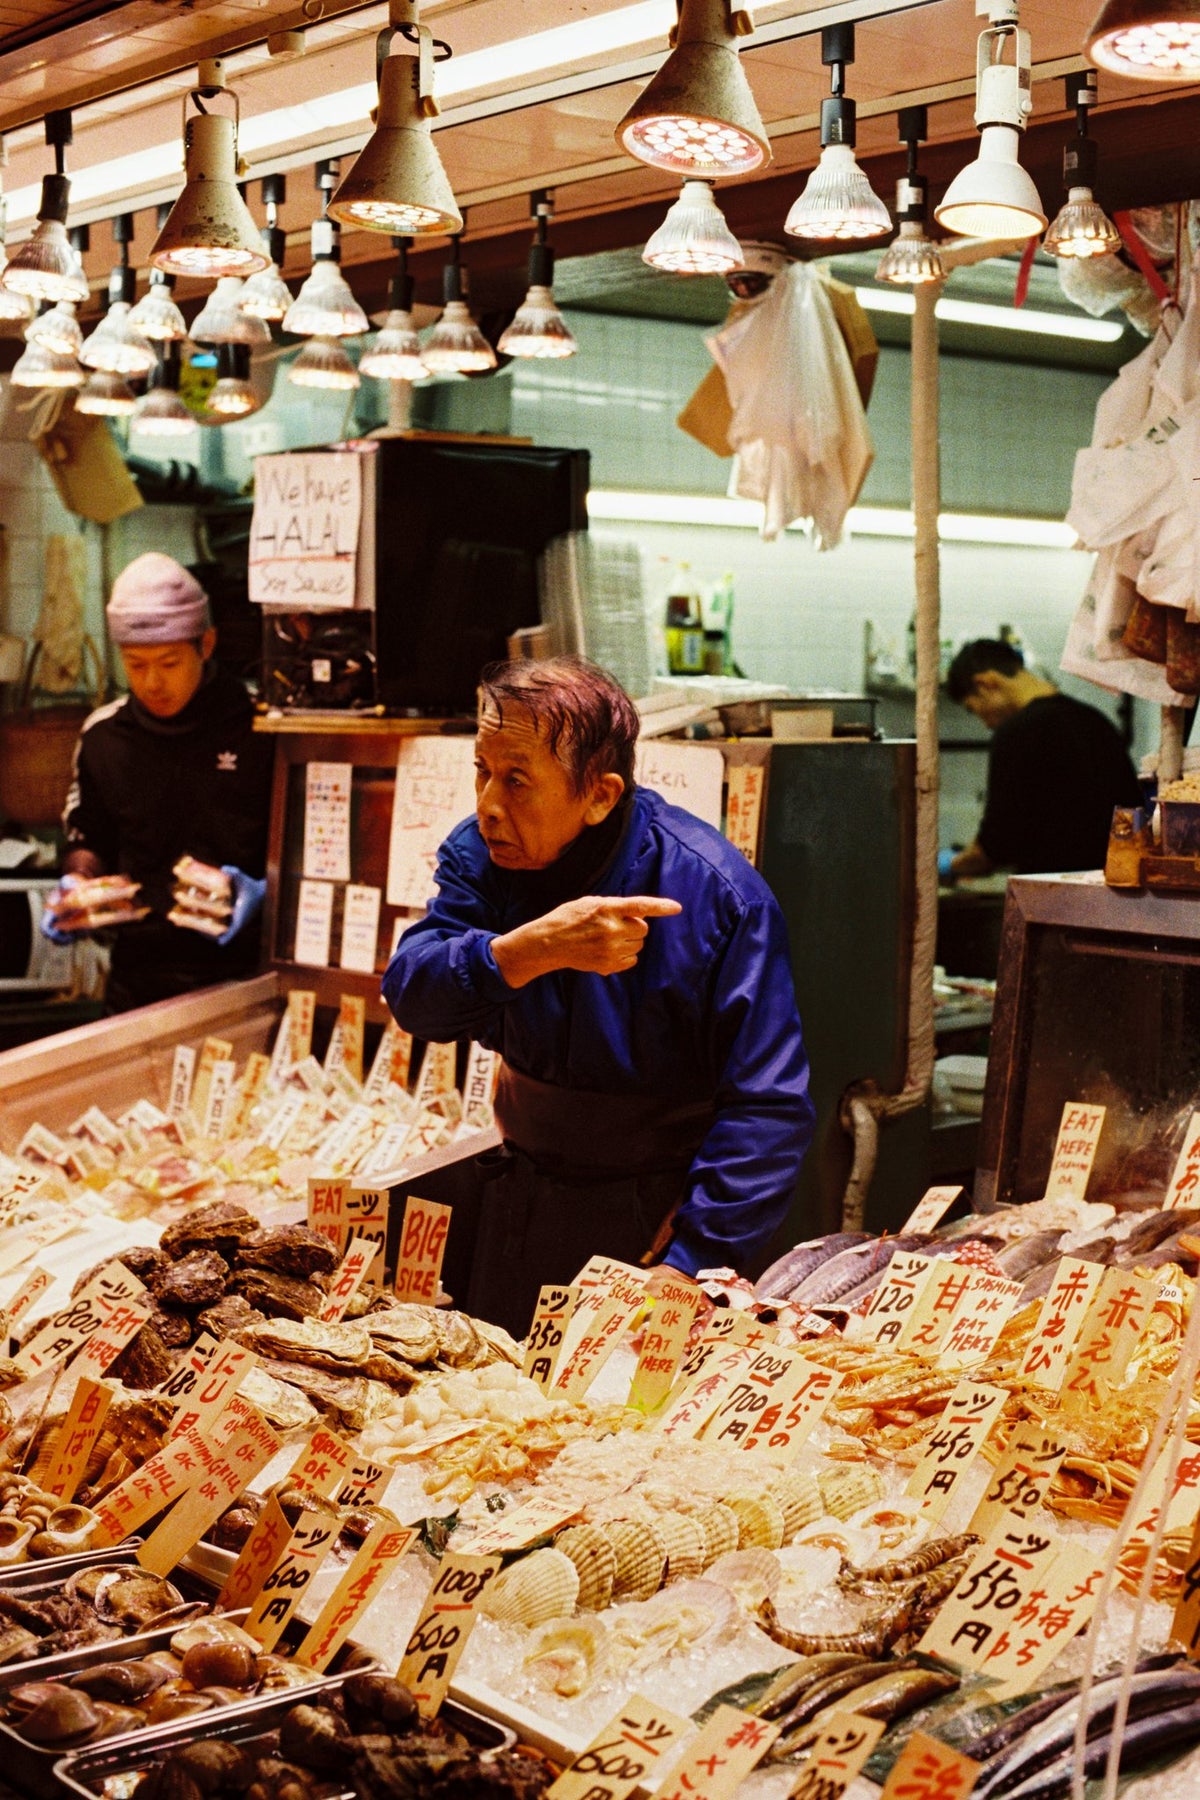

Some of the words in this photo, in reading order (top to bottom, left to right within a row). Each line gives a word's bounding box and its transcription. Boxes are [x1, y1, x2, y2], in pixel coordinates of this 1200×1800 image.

[255, 514, 352, 556] HALAL
[1063, 1110, 1100, 1134] EAT
[1057, 1139, 1095, 1157] HERE
[312, 1186, 343, 1215] EAT
[346, 1194, 379, 1216] 一ツ
[402, 1210, 449, 1264] BIG
[891, 1259, 929, 1279] 一ツ
[99, 1279, 134, 1301] 一ツ
[396, 1267, 437, 1298] SIZE
[657, 1282, 701, 1308] SASHIMI
[970, 1277, 1023, 1299] SASHIMI
[539, 1291, 570, 1313] 一ツ
[868, 1286, 914, 1316] 120
[975, 1297, 1004, 1313] OK
[53, 1299, 103, 1335] 800
[101, 1307, 145, 1337] EAT
[661, 1310, 682, 1327] OK
[952, 1317, 989, 1333] EAT
[1024, 1264, 1089, 1374] 赤えび
[528, 1319, 563, 1351] 350
[643, 1333, 673, 1352] EAT
[875, 1320, 903, 1344] 円
[81, 1333, 124, 1369] HERE
[681, 1345, 715, 1377] 25
[528, 1357, 553, 1384] 円
[639, 1356, 675, 1374] HERE
[223, 1397, 251, 1419] SASHI
[719, 1383, 769, 1417] 700
[951, 1392, 996, 1415] 一ツ
[240, 1414, 280, 1457] SASHIMI
[717, 1418, 749, 1442] 円
[234, 1442, 257, 1463] OK
[923, 1425, 975, 1463] 450
[1015, 1439, 1068, 1462] 一ツ
[172, 1451, 197, 1472] OK
[303, 1459, 332, 1482] OK
[351, 1464, 383, 1485] 一ツ
[131, 1477, 155, 1500] OK
[198, 1481, 220, 1501] OK
[923, 1469, 959, 1496] 円
[988, 1468, 1041, 1506] 550
[108, 1486, 135, 1514] EAT
[294, 1528, 332, 1550] 一ツ
[1005, 1533, 1050, 1555] 一ツ
[262, 1554, 312, 1593] 600
[432, 1566, 495, 1603] 100g
[956, 1559, 1022, 1610] 550
[257, 1597, 293, 1624] 円
[404, 1611, 461, 1656] 600
[950, 1620, 993, 1654] 円
[416, 1652, 449, 1683] 円
[620, 1717, 673, 1740] 一ツ
[568, 1739, 645, 1780] 600
